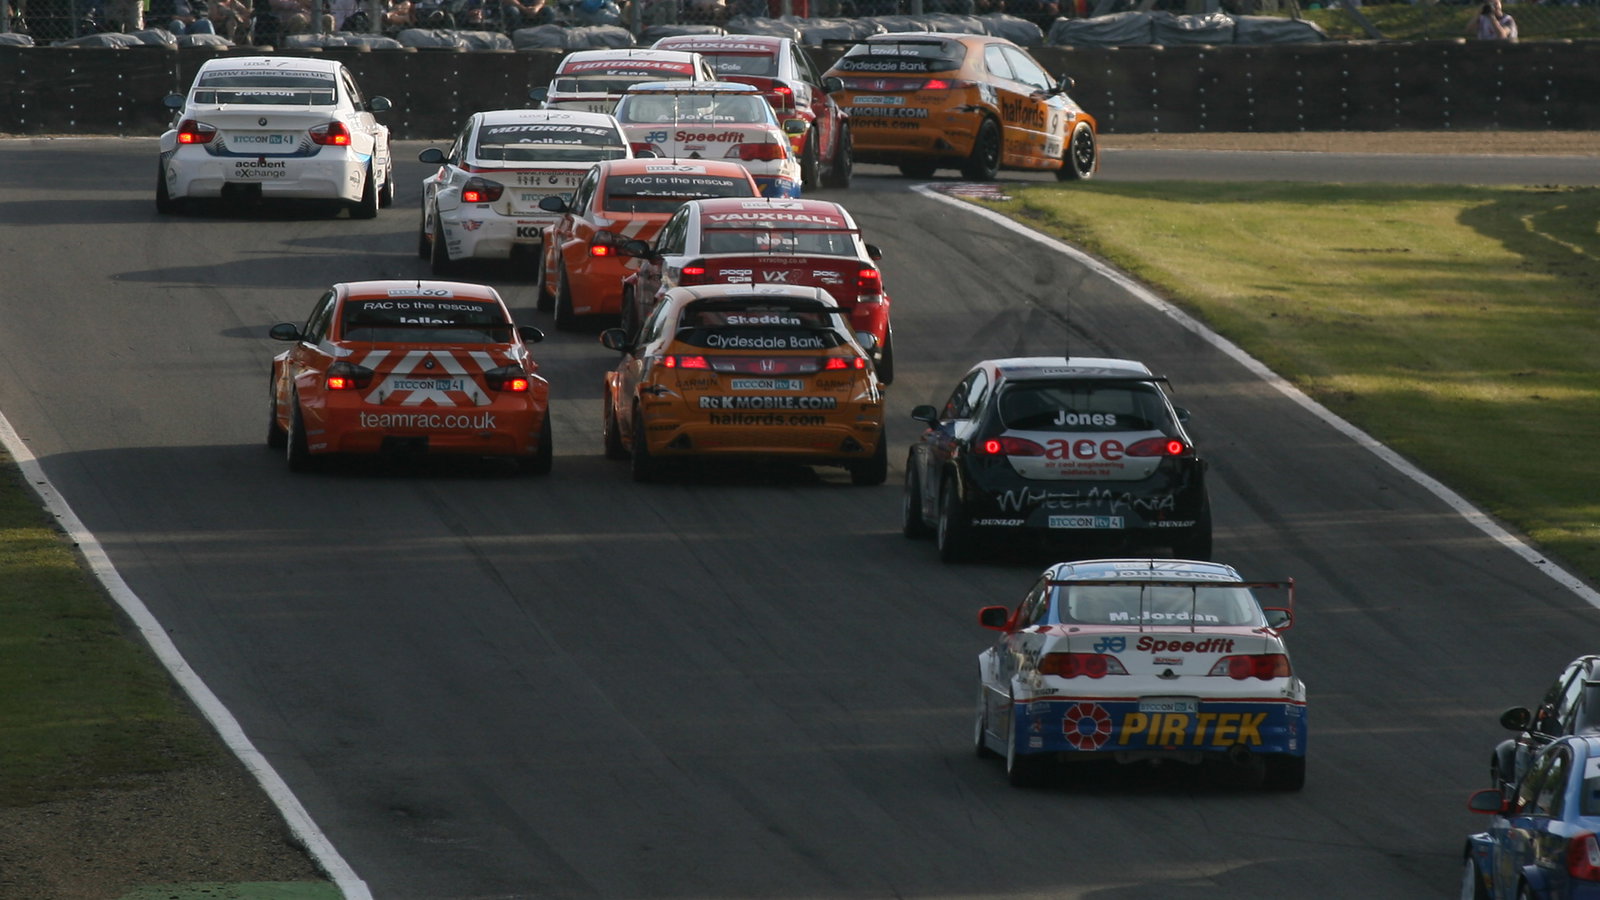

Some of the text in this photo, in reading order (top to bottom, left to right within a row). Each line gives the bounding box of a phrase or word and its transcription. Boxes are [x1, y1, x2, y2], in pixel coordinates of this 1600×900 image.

[666, 43, 771, 51] VAUXHALL
[572, 60, 685, 70] MOTORBASE
[843, 61, 928, 70] Clydesdale Bank
[844, 107, 928, 117] KMOBILE.COM
[1002, 96, 1044, 128] halfords
[1051, 114, 1058, 134] 9
[488, 125, 609, 136] MOTORBASE
[674, 131, 744, 143] Speedfit
[235, 169, 286, 177] eXchange
[709, 213, 840, 224] VAUXHALL
[756, 235, 799, 245] Neal
[719, 269, 753, 277] pogo
[363, 302, 393, 310] RAC
[438, 303, 483, 312] rescue
[727, 315, 801, 325] Shedden
[707, 335, 825, 348] Clydesdale Bank
[360, 411, 497, 429] teamrac.co.uk
[710, 412, 825, 426] halfords.com
[1053, 409, 1117, 426] Jones
[1045, 438, 1124, 461] ace
[979, 519, 1025, 527] DUNLOP
[1109, 611, 1219, 622] M.Jordan
[1136, 636, 1235, 654] Speedfit
[1118, 713, 1268, 746] PIRTEK
